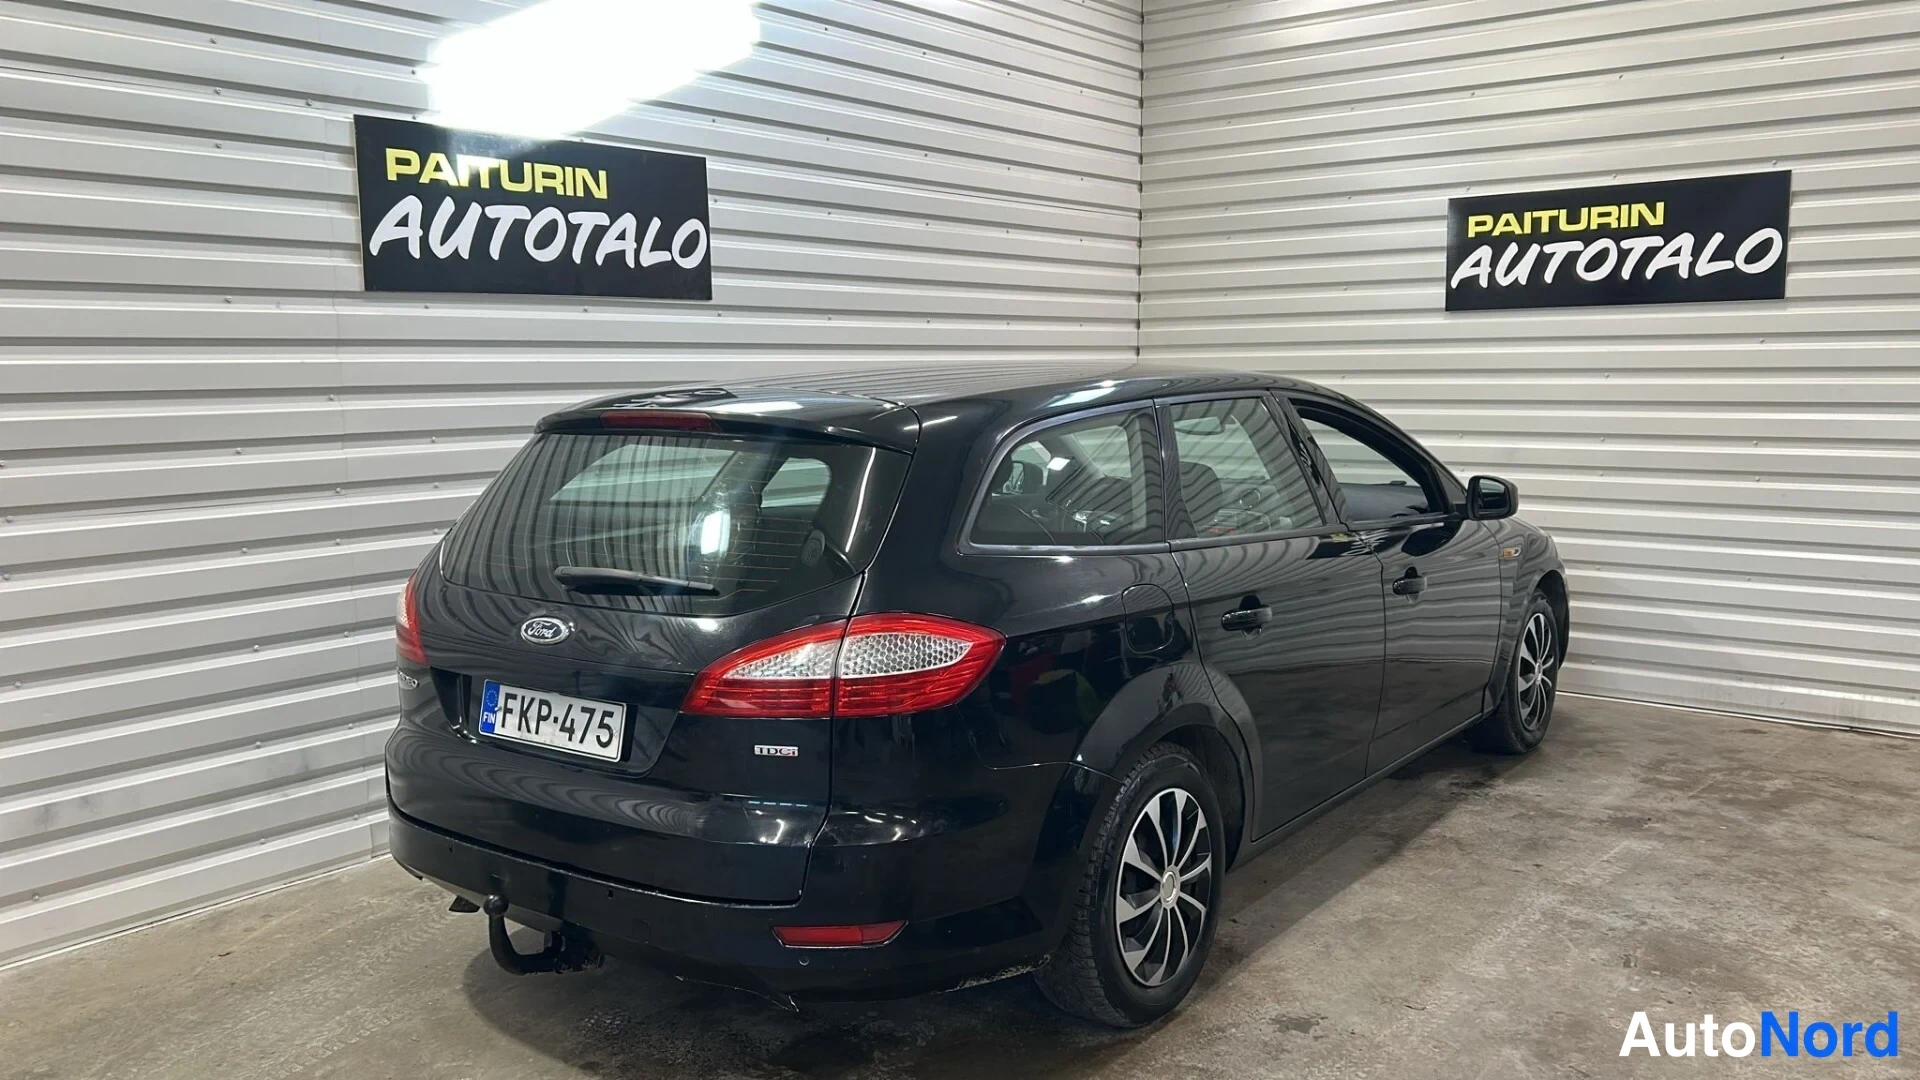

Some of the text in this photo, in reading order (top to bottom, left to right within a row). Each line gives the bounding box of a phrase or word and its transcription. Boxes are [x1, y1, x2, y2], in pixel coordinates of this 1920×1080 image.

[385, 148, 608, 199] PAITURIN
[369, 195, 708, 269] AUTOTALO
[1468, 202, 1665, 238] PAITURIN
[1450, 227, 1783, 289] AUTOTALO
[526, 620, 557, 640] Ford
[483, 711, 496, 724] FIN
[501, 692, 615, 749] FKP-475
